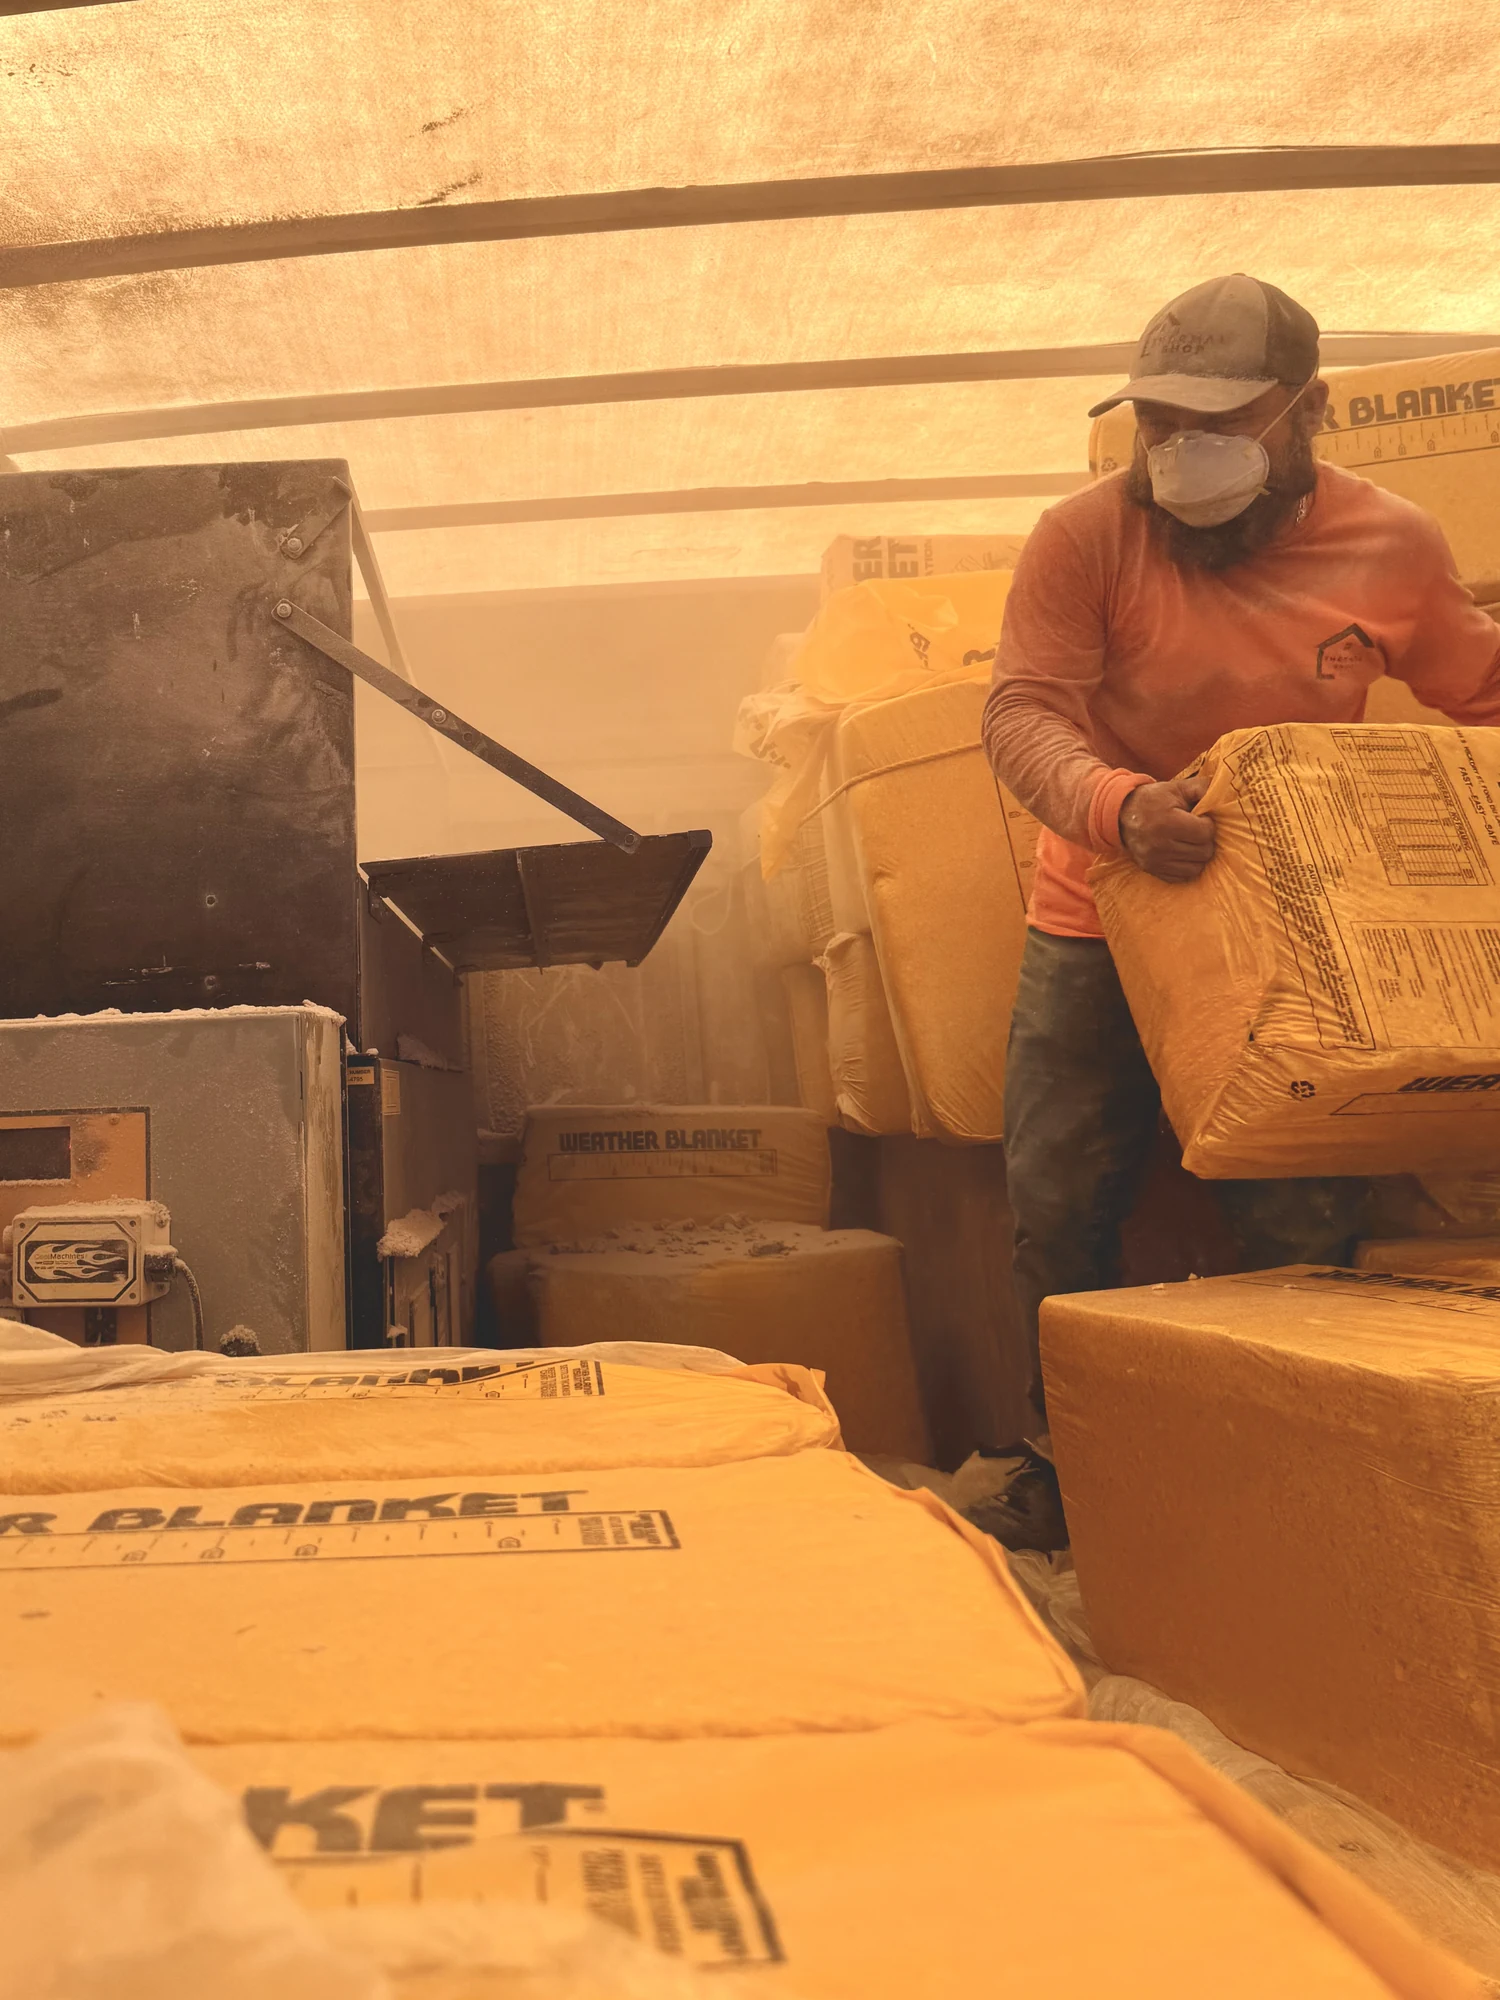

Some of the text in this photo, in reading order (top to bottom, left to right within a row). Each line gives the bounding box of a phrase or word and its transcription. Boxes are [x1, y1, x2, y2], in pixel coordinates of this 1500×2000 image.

[558, 1128, 762, 1151] WEATHER BLANKET
[0, 1511, 57, 1535] R
[87, 1490, 588, 1532] BLANKET
[243, 1782, 604, 1854] KET
